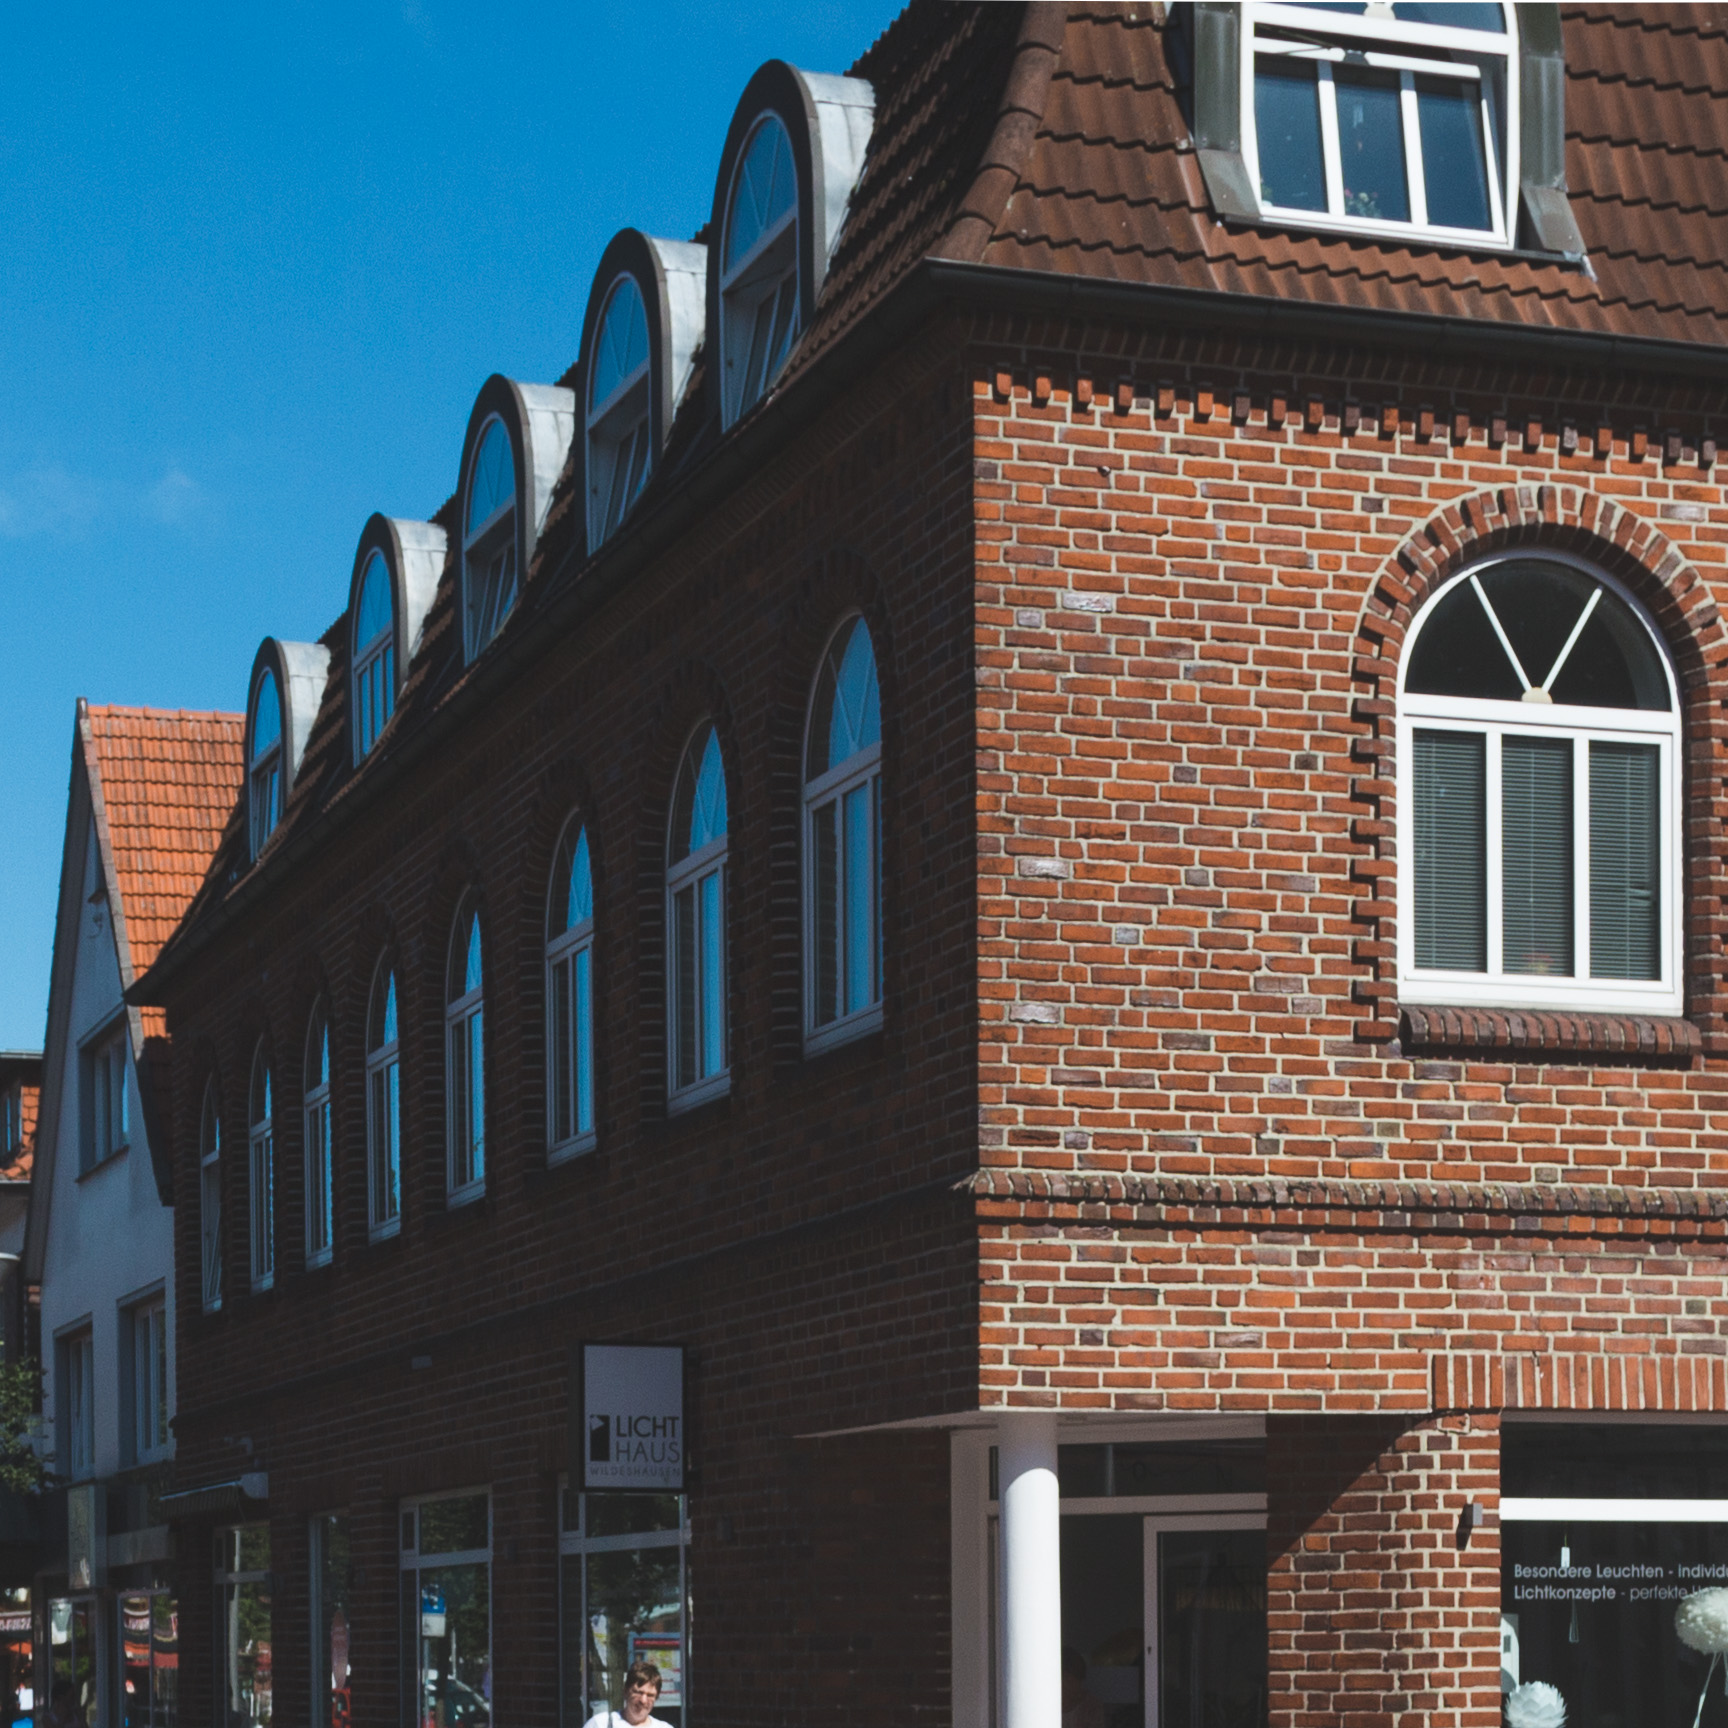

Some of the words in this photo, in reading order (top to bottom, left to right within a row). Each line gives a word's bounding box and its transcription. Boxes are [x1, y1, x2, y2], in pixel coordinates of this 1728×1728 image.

[616, 1416, 680, 1438] LICHT
[616, 1441, 681, 1463] HAUS
[589, 1466, 680, 1477] WILDESHAUSEN
[1514, 1564, 1592, 1579] Besondere
[1596, 1564, 1664, 1579] Leuchten
[1514, 1585, 1616, 1603] Lichtkonzepte
[1630, 1585, 1687, 1603] perfekte
